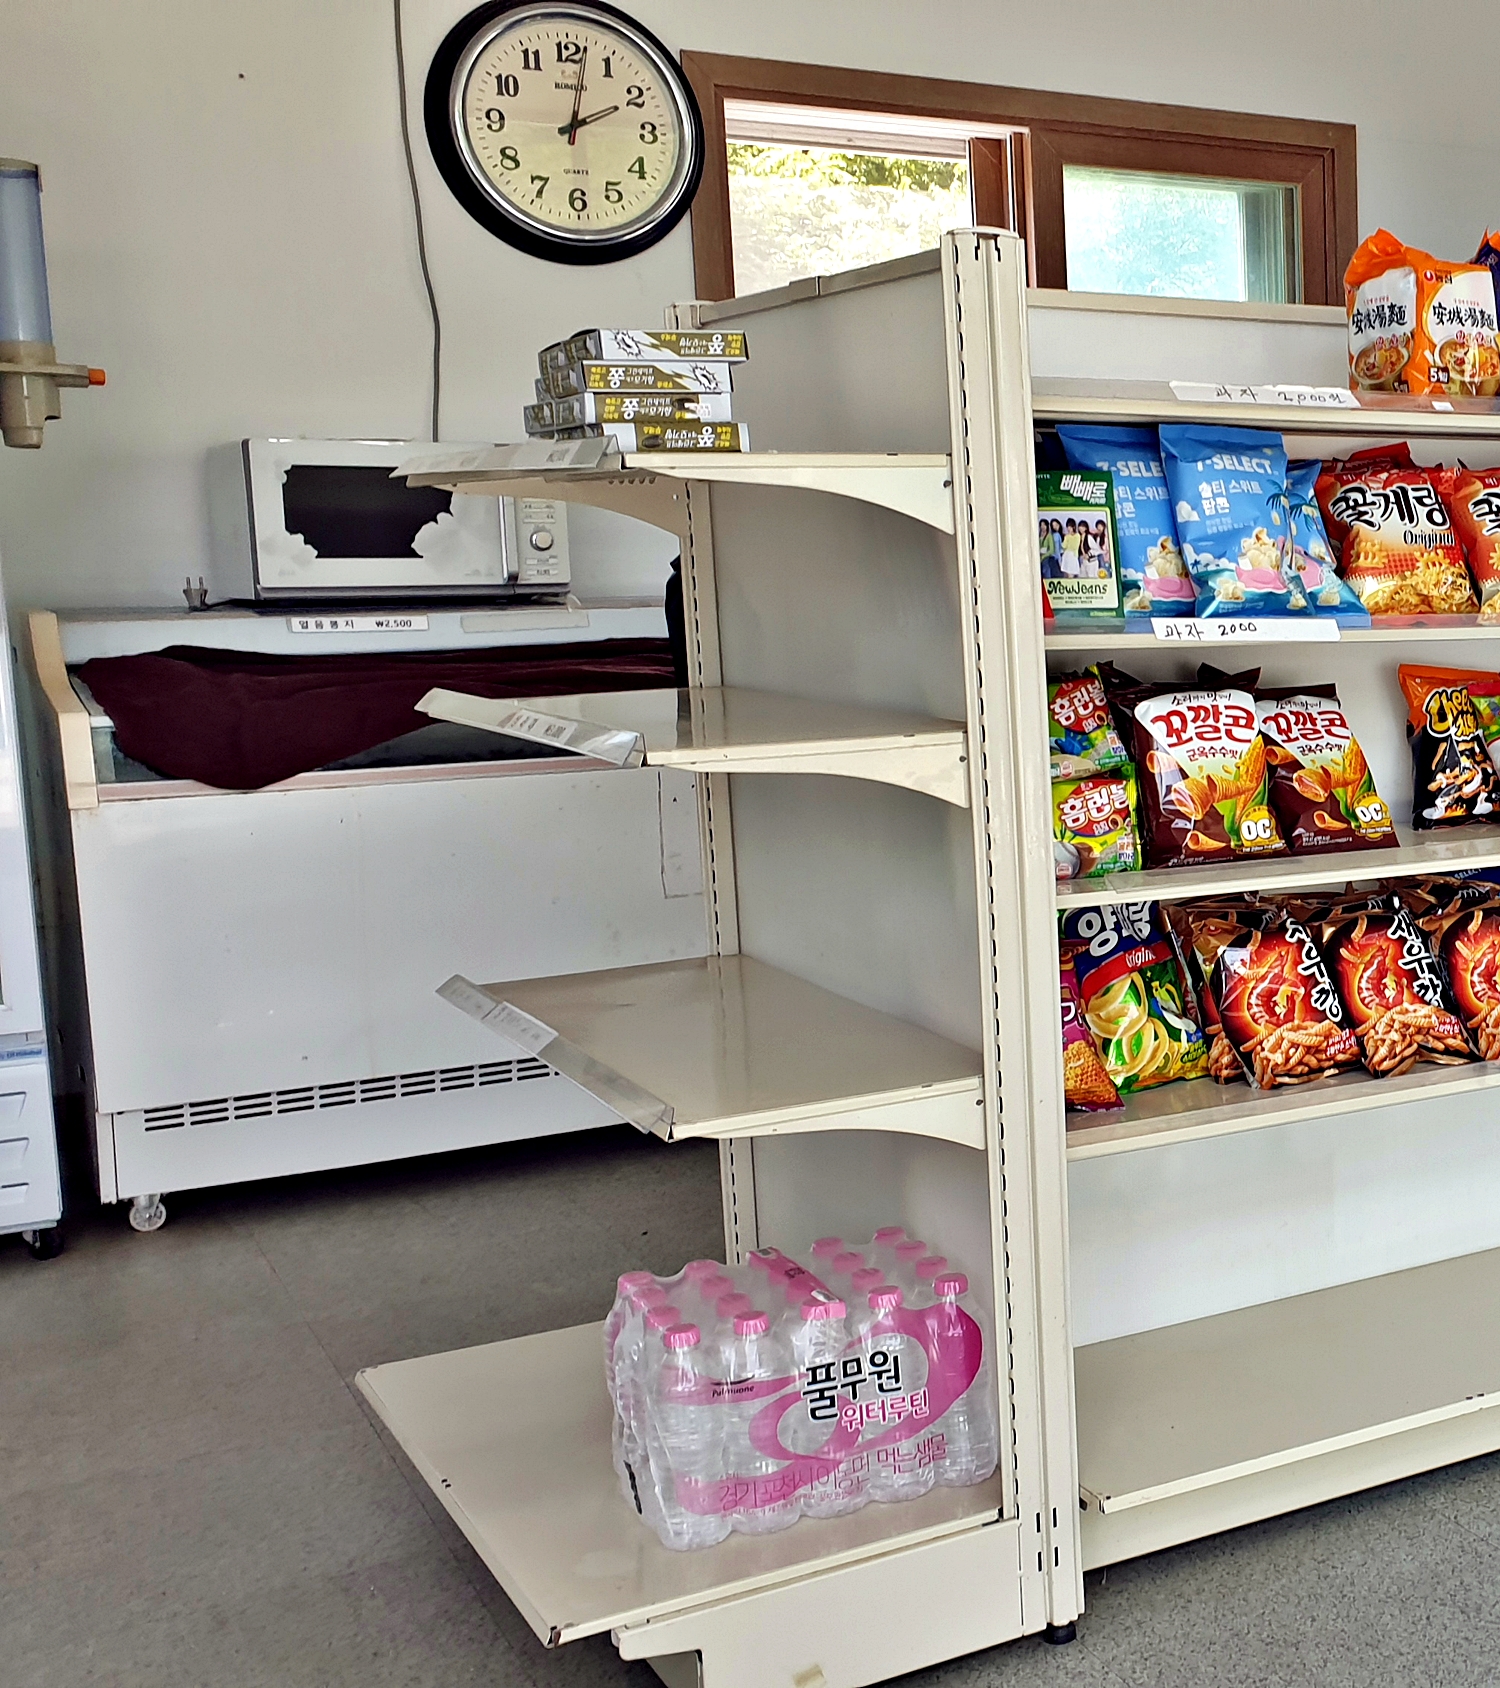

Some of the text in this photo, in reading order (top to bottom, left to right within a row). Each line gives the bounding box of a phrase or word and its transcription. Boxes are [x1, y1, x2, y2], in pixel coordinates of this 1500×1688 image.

[521, 47, 543, 72] 11
[555, 40, 582, 64] 12
[601, 56, 614, 79] 1
[495, 73, 520, 97] 10
[625, 85, 646, 109] 2
[485, 107, 506, 133] 9
[639, 121, 659, 145] 3
[500, 146, 520, 171] 8
[627, 156, 647, 180] 4
[530, 174, 550, 199] 7
[604, 180, 624, 204] 5
[568, 188, 588, 212] 6
[1060, 474, 1108, 502] 빼빼로
[1228, 479, 1263, 495] 스위트
[1329, 485, 1450, 531] 꽃게랑
[1048, 580, 1108, 595] NewJeans
[375, 619, 412, 628] ₩2,500
[1164, 622, 1258, 641] 과자 2000
[1050, 680, 1107, 727] 홈런볼
[1150, 704, 1256, 749] 꼬깔콘
[1261, 709, 1351, 744] 꼬깔콘
[1185, 745, 1238, 763] 군옥수수맛
[1060, 780, 1130, 828] 홈런볼
[802, 1350, 903, 1421] 풀무원
[841, 1389, 930, 1431] 워터루틴
[876, 1432, 949, 1475] 먹는샘물
